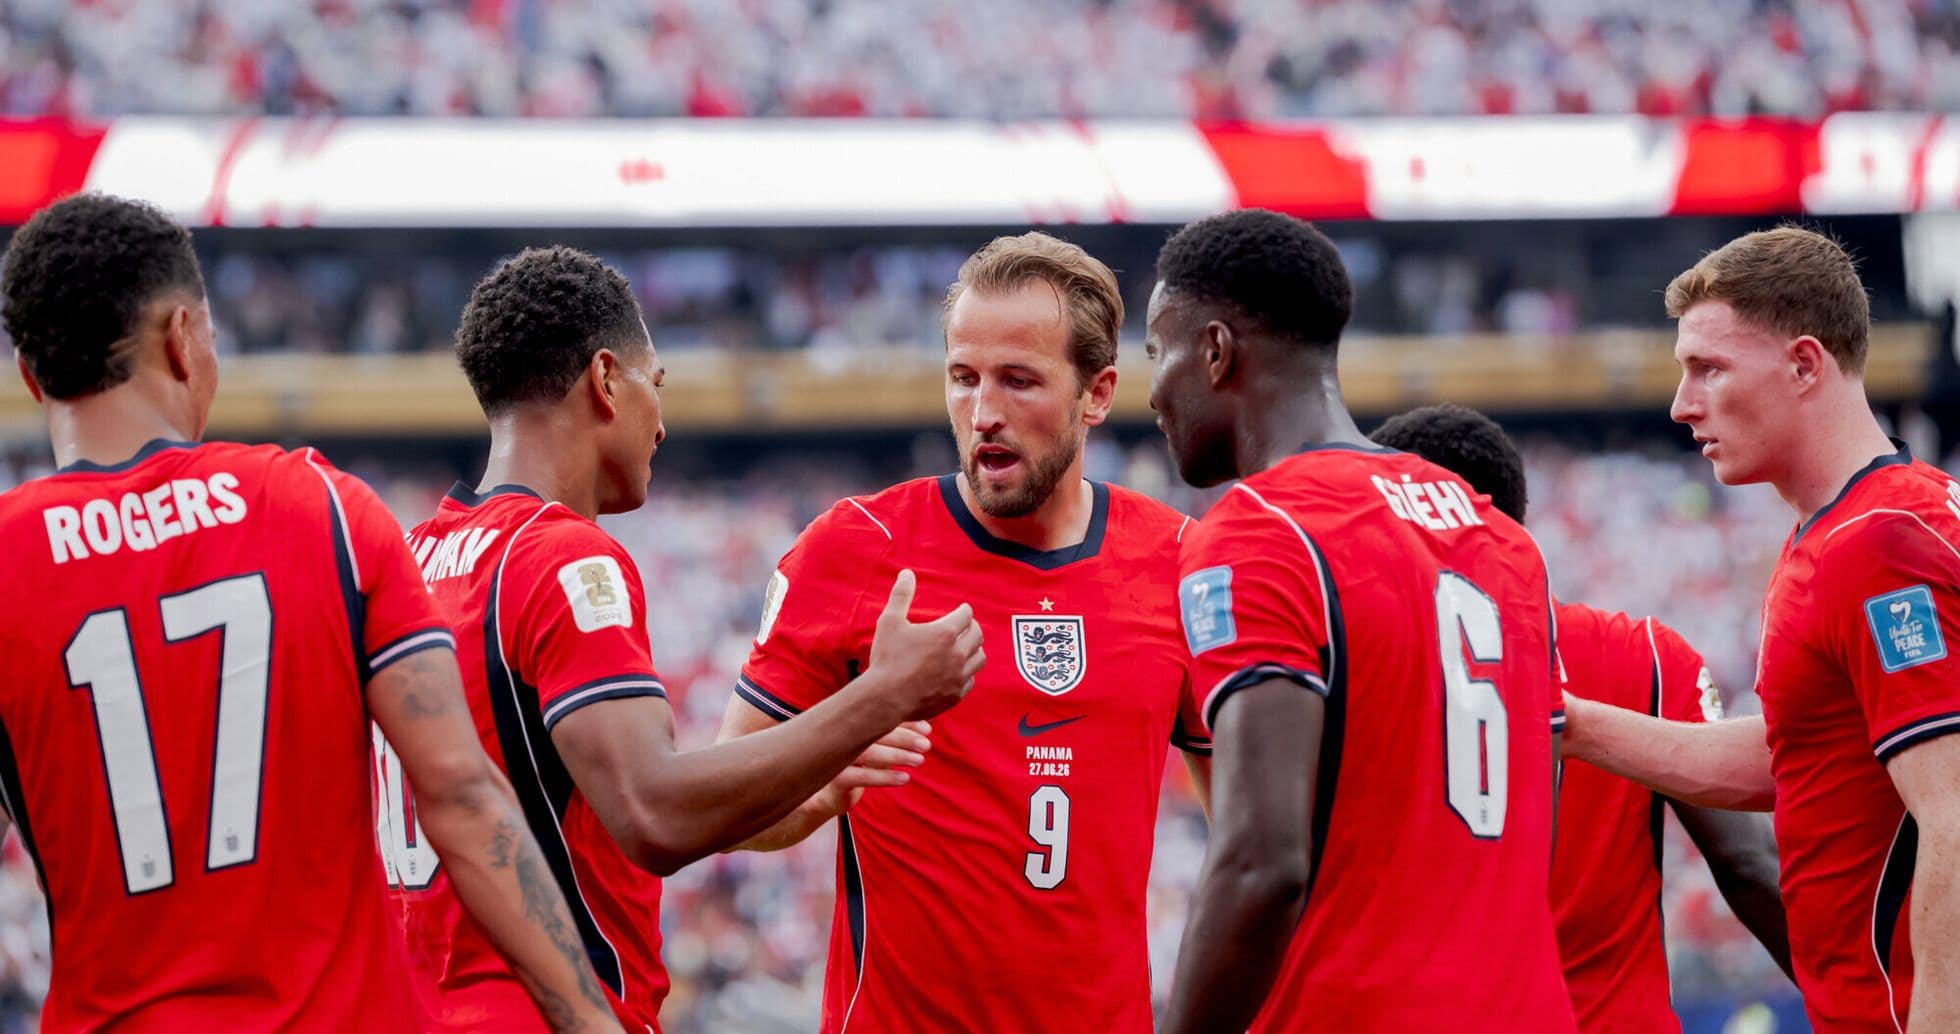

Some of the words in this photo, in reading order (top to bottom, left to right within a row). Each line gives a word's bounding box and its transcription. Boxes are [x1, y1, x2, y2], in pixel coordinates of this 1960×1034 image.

[43, 472, 247, 564] ROGERS
[1894, 632, 1927, 653] PEACE
[63, 571, 273, 896] 17
[1435, 570, 1508, 841] 6
[1026, 746, 1073, 761] PANAMA
[1029, 762, 1070, 776] 27.06.26
[1024, 784, 1070, 890] 9
